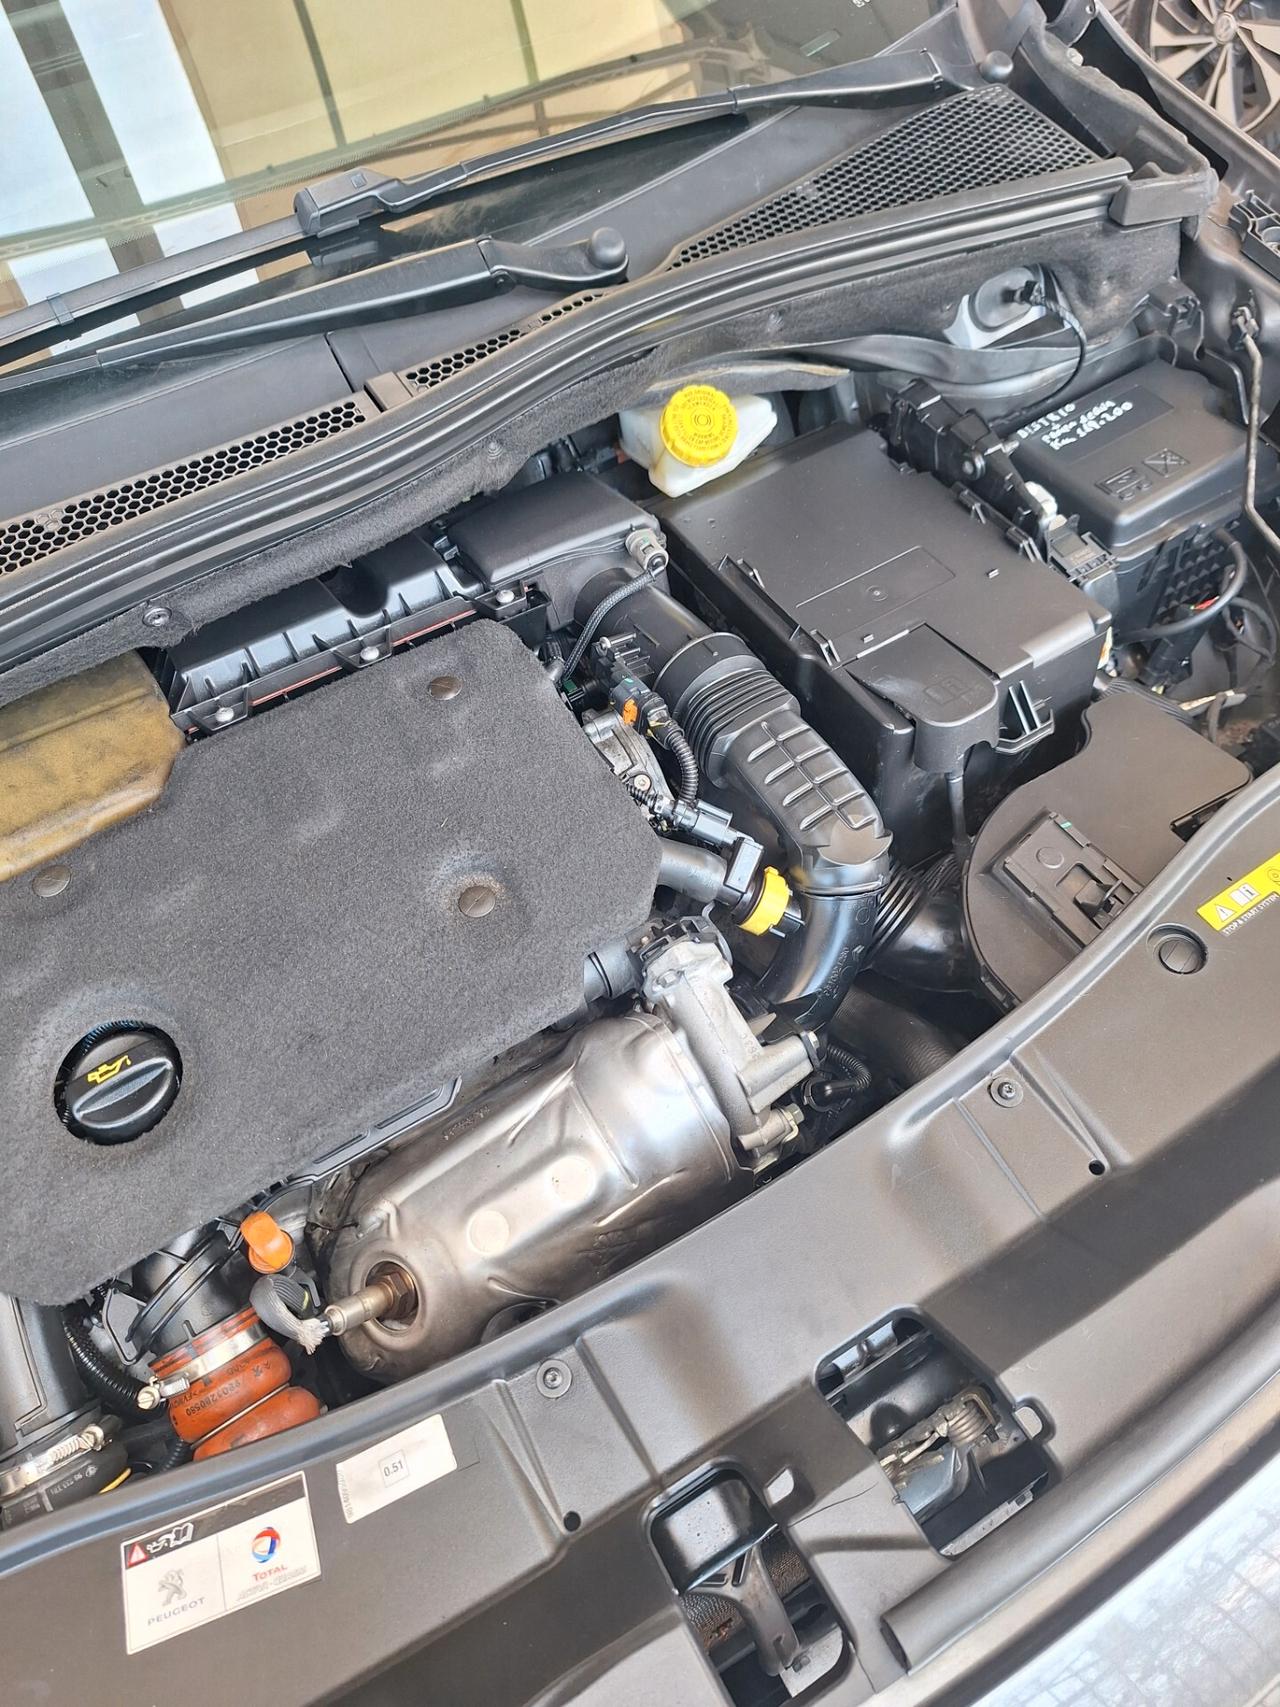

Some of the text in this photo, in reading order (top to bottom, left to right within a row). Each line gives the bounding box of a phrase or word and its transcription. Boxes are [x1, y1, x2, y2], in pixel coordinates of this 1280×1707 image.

[384, 1459, 403, 1477] 0.51
[253, 1564, 288, 1581] TOTAL
[147, 1597, 205, 1626] PEUGEOT
